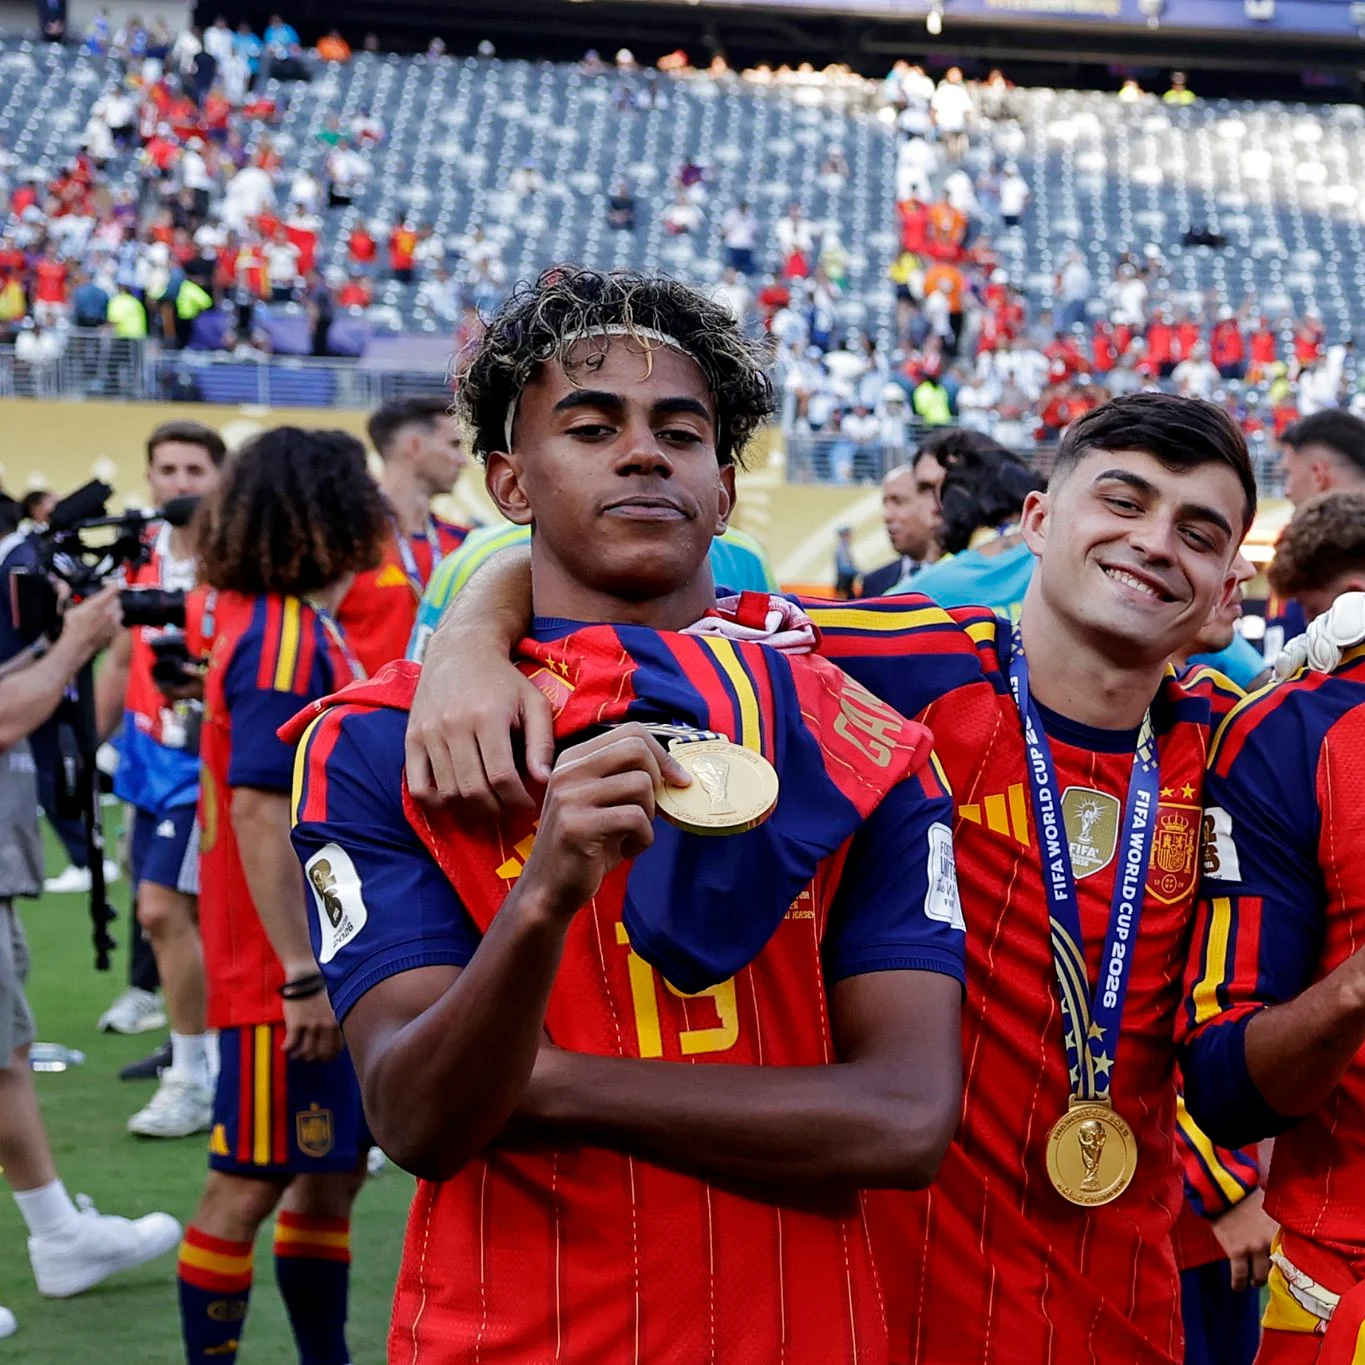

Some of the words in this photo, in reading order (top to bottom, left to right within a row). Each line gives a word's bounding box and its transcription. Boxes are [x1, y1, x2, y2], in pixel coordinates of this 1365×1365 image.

[1028, 746, 1049, 787] CUP
[1039, 788, 1062, 857] WORLD
[1131, 789, 1151, 829] FIFA
[1053, 861, 1069, 902] FIFA
[1121, 831, 1145, 901] WORLD
[1115, 902, 1135, 942] CUP
[1103, 941, 1126, 1010] 2026
